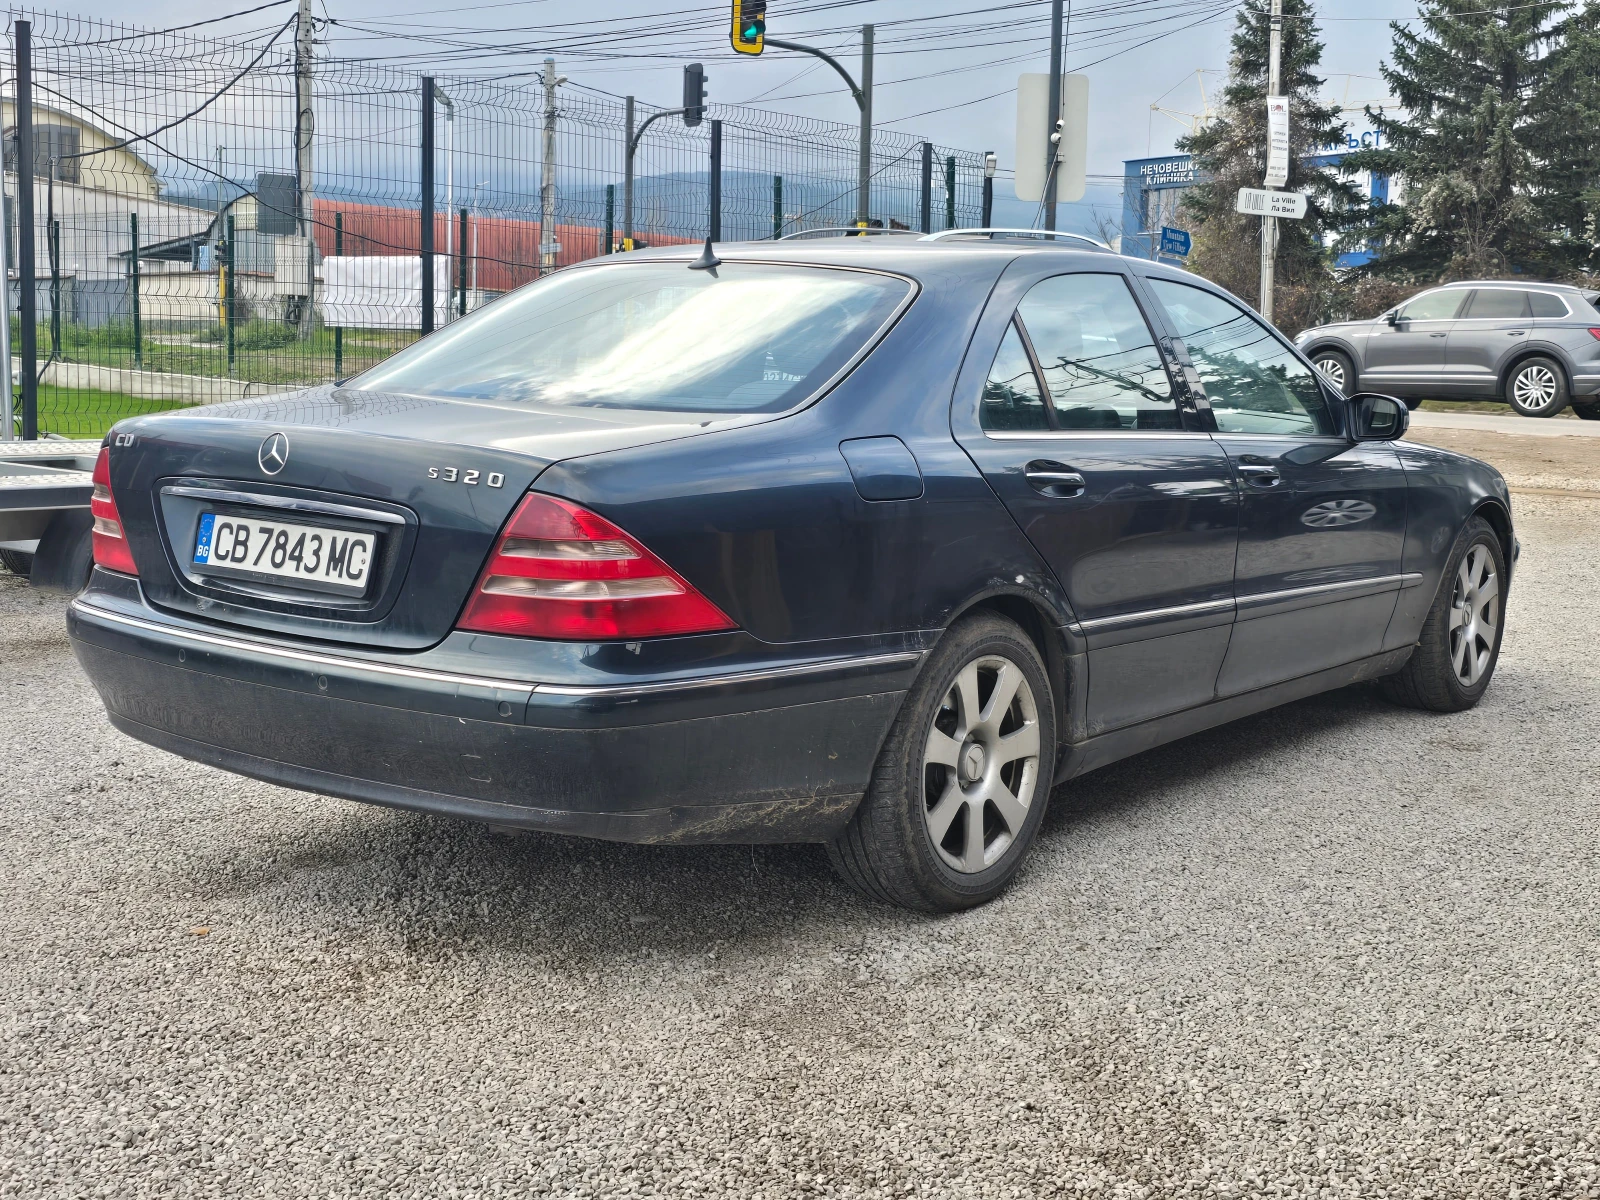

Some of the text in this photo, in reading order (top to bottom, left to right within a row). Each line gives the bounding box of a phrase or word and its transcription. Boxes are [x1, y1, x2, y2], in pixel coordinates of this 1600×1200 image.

[1146, 171, 1194, 185] КЛИНИКА
[1281, 197, 1296, 205] Ville
[196, 545, 209, 557] BG
[252, 527, 323, 574] 7843
